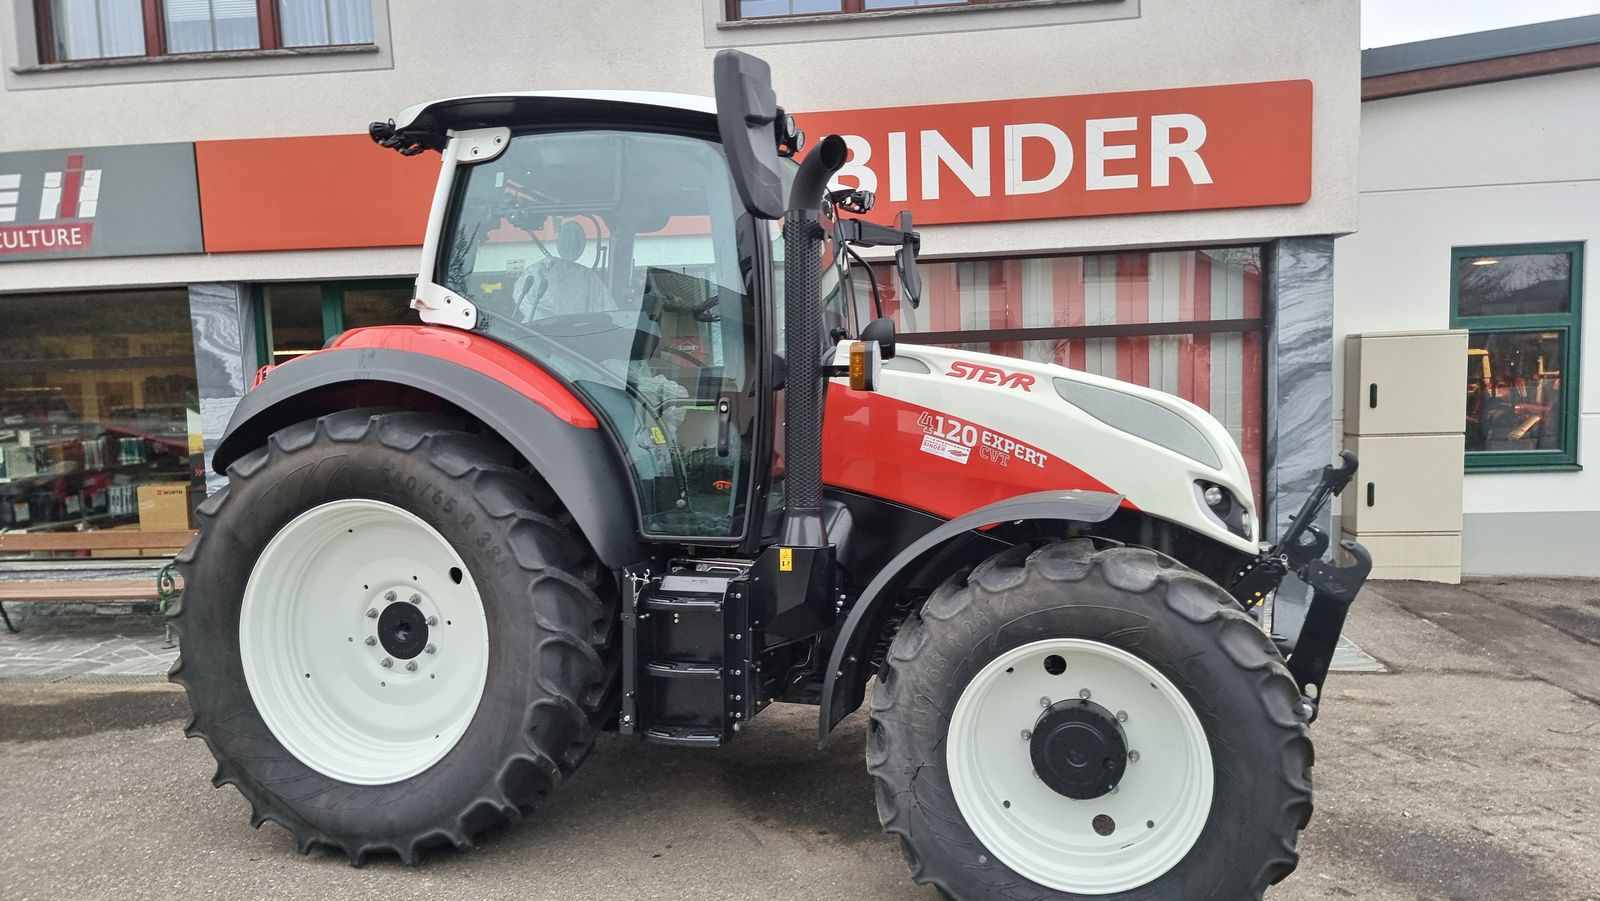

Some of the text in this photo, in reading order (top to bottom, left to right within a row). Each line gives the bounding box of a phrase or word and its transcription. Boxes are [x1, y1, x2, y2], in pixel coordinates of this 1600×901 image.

[820, 113, 1214, 203] BINDER
[0, 228, 82, 249] ULTURE
[945, 361, 1036, 392] STEYR
[917, 411, 978, 448] 4120
[981, 430, 1048, 468] EXPERT
[979, 445, 1010, 467] CVT
